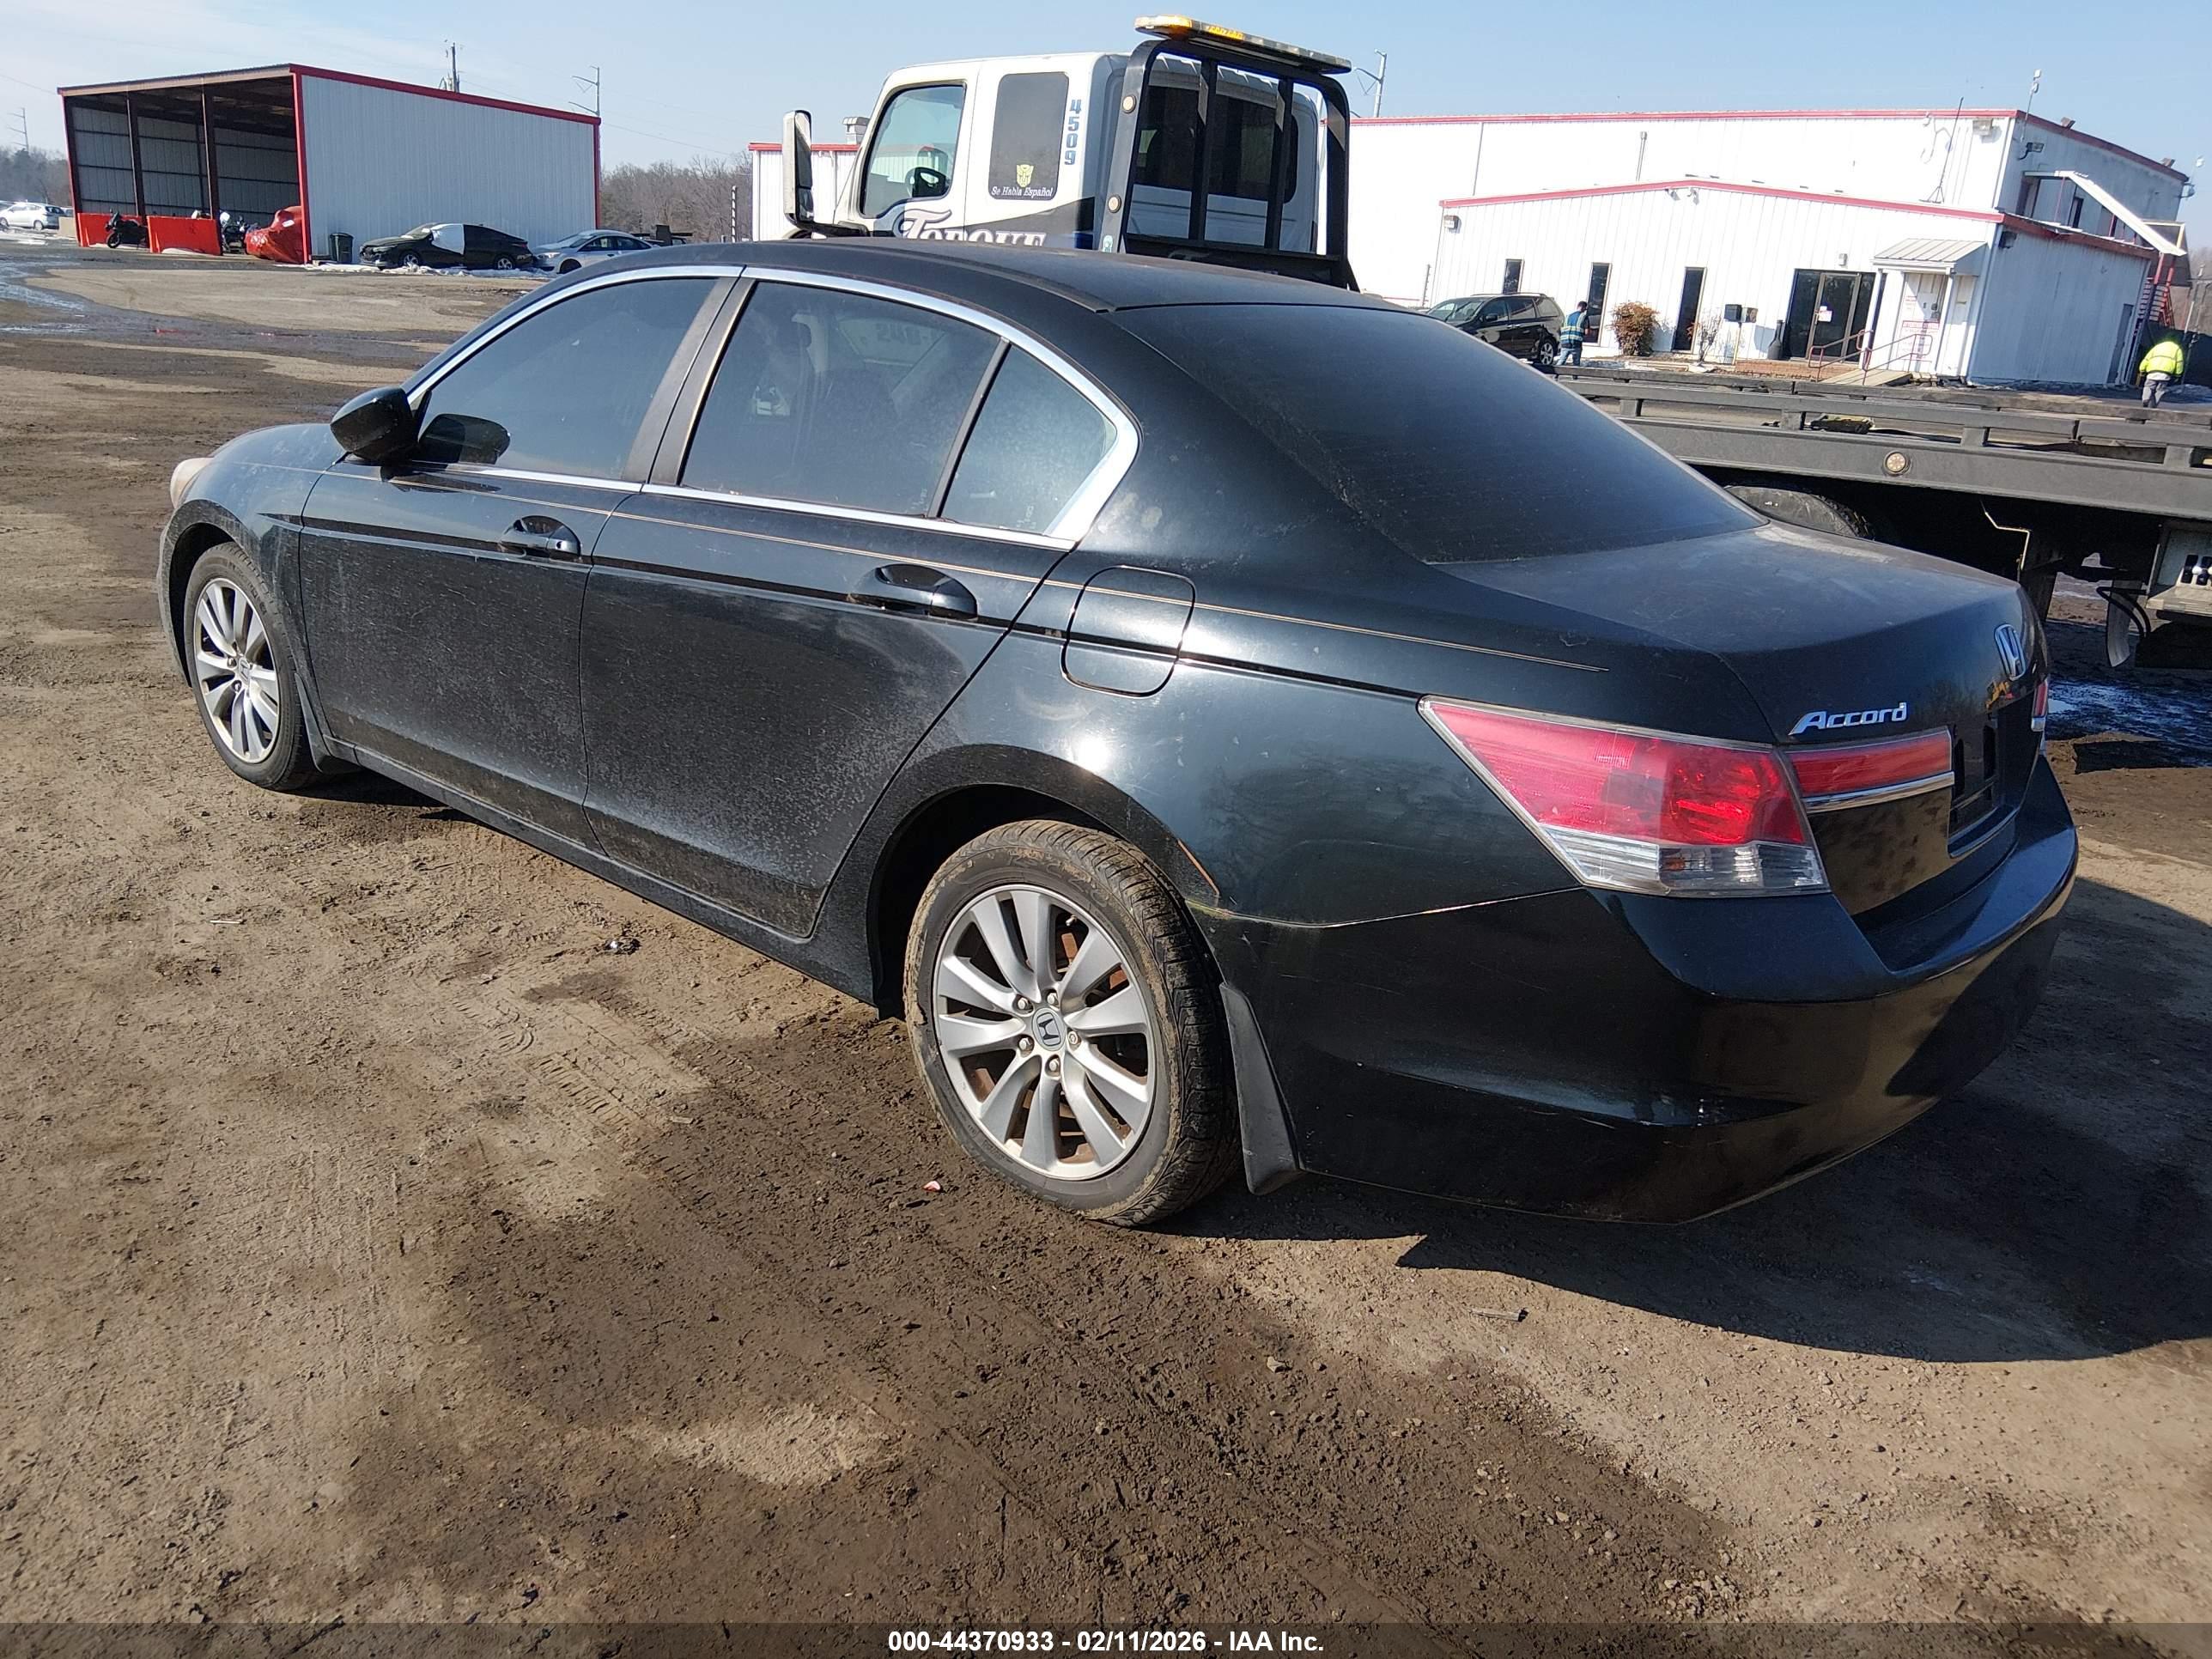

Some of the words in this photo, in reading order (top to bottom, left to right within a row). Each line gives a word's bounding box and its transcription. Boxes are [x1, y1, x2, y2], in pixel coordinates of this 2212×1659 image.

[1064, 99, 1082, 165] 4509
[991, 185, 1001, 196] Se
[1001, 186, 1022, 196] Habla
[1023, 186, 1054, 198] Español
[1788, 702, 1907, 736] Accord
